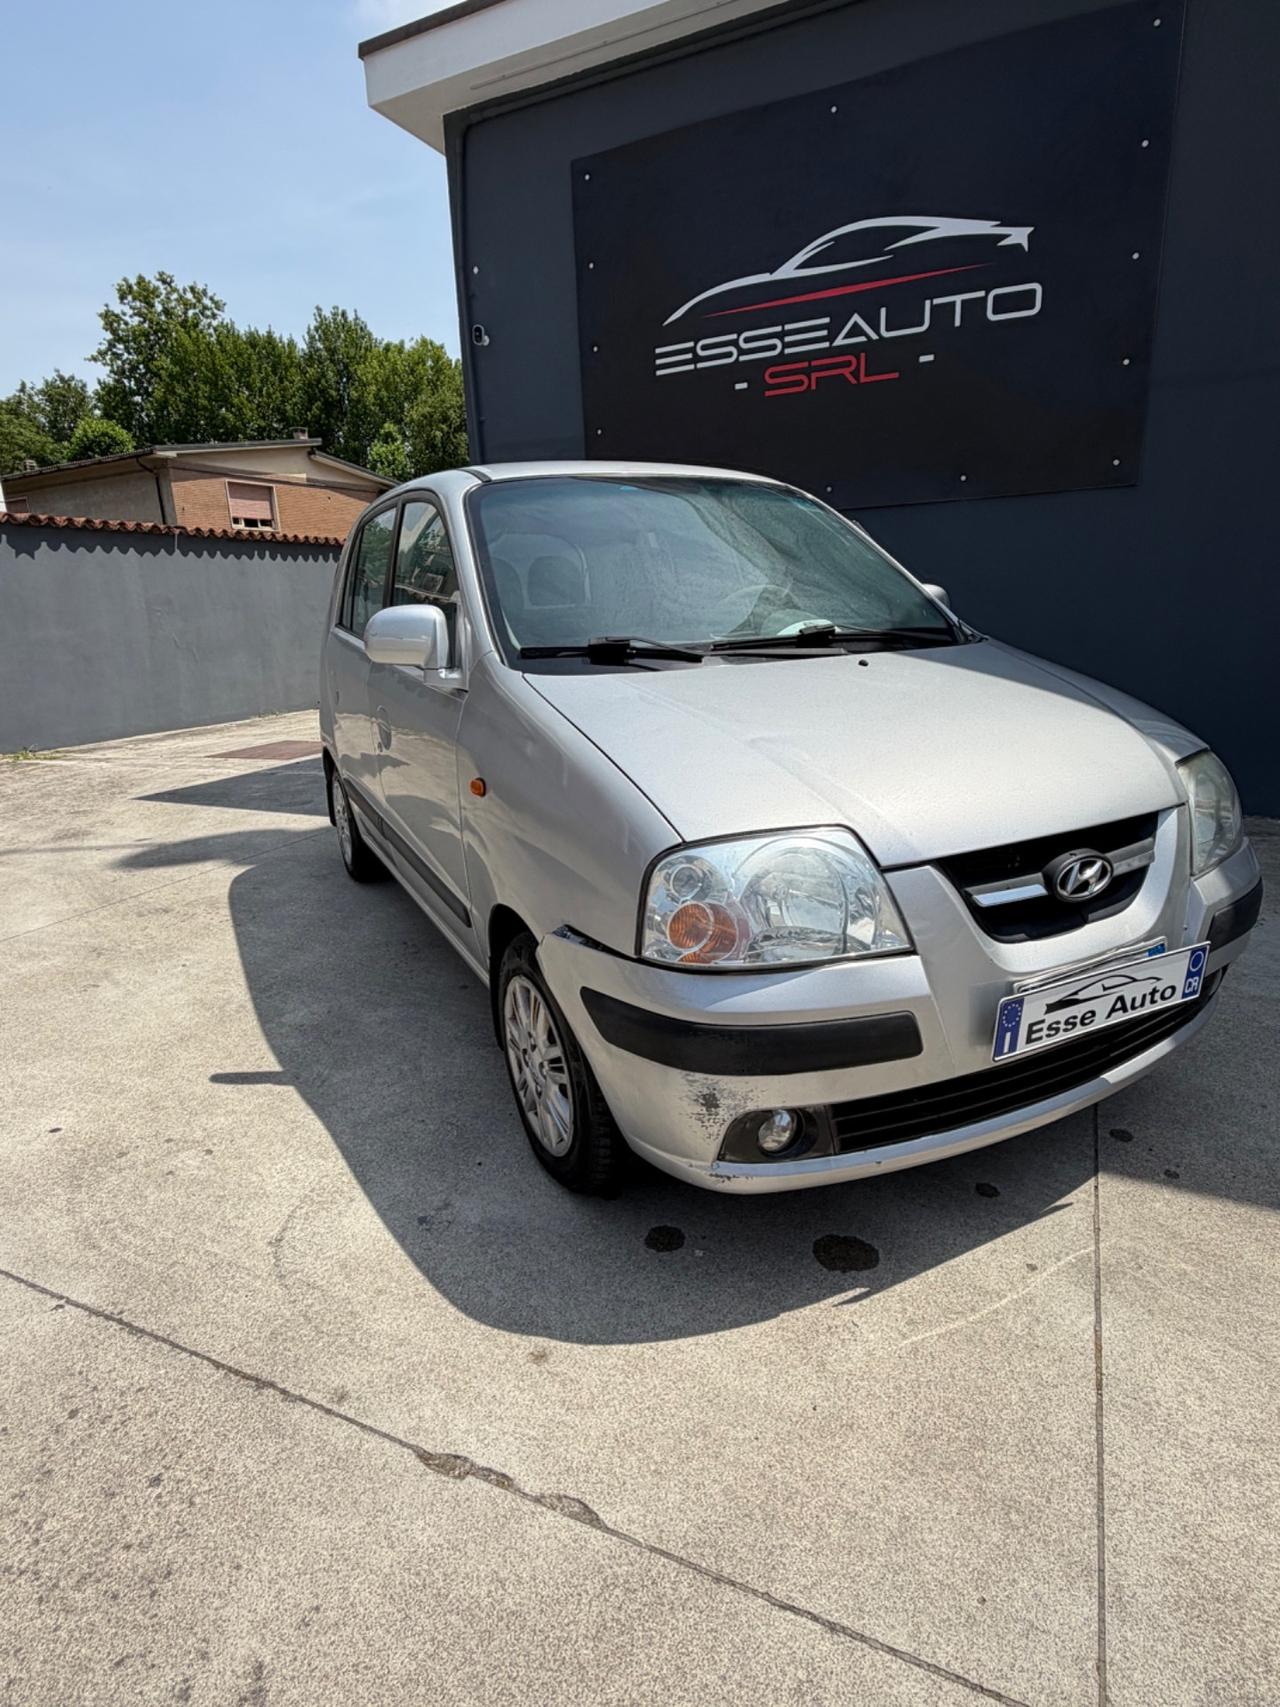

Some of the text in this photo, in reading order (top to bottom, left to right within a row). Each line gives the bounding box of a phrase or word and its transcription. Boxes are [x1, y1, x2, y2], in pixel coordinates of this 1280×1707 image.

[655, 282, 1043, 376] ESSEAUTO
[764, 353, 899, 397] SRL
[1025, 984, 1177, 1045] Esse Auto
